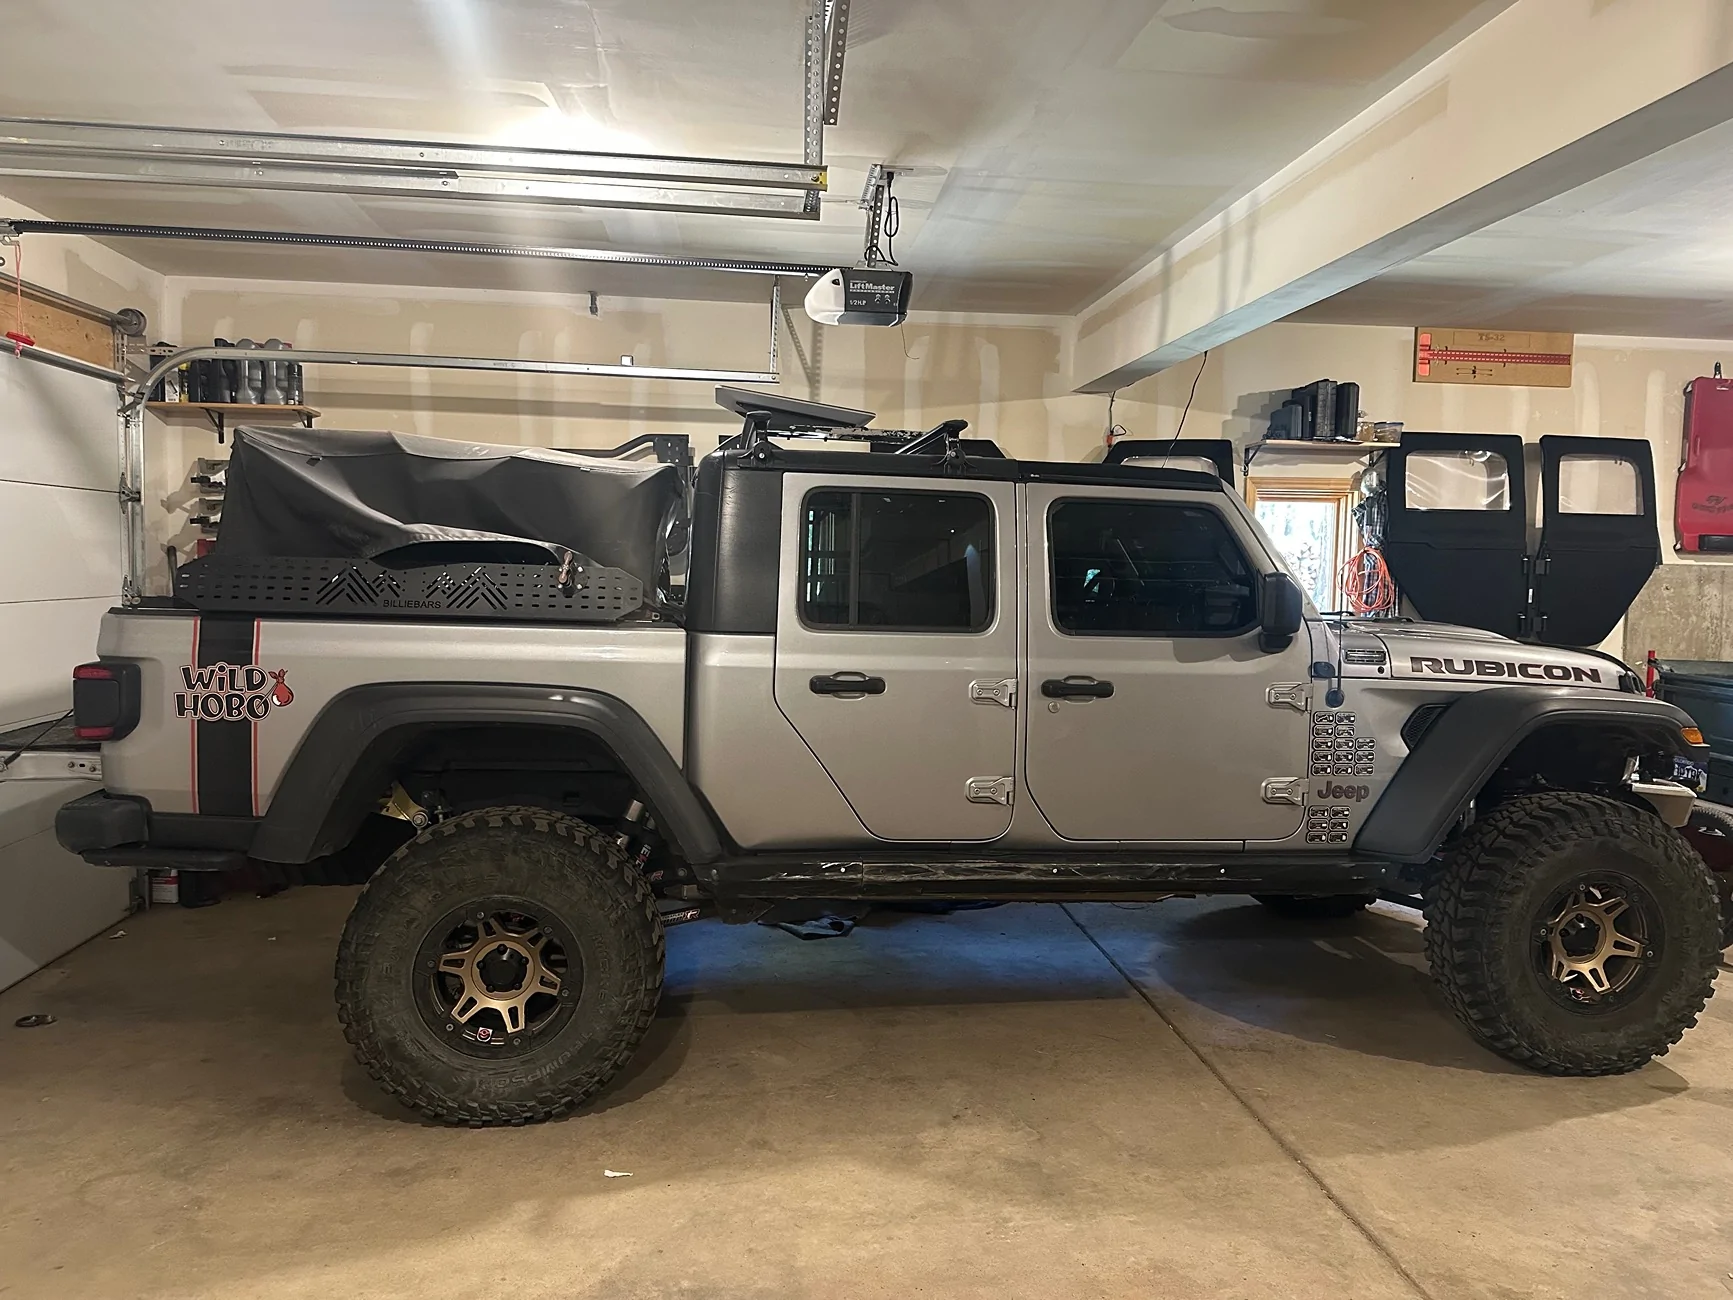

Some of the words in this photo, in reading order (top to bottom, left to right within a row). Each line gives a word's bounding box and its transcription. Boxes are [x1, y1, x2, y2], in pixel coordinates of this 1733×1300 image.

[849, 282, 895, 291] LiftMaster
[1478, 332, 1505, 341] TS-32
[383, 599, 442, 609] BILLIEBARS
[1409, 656, 1602, 684] RUBICON
[174, 692, 271, 721] HOBO
[1317, 780, 1370, 803] Jeep
